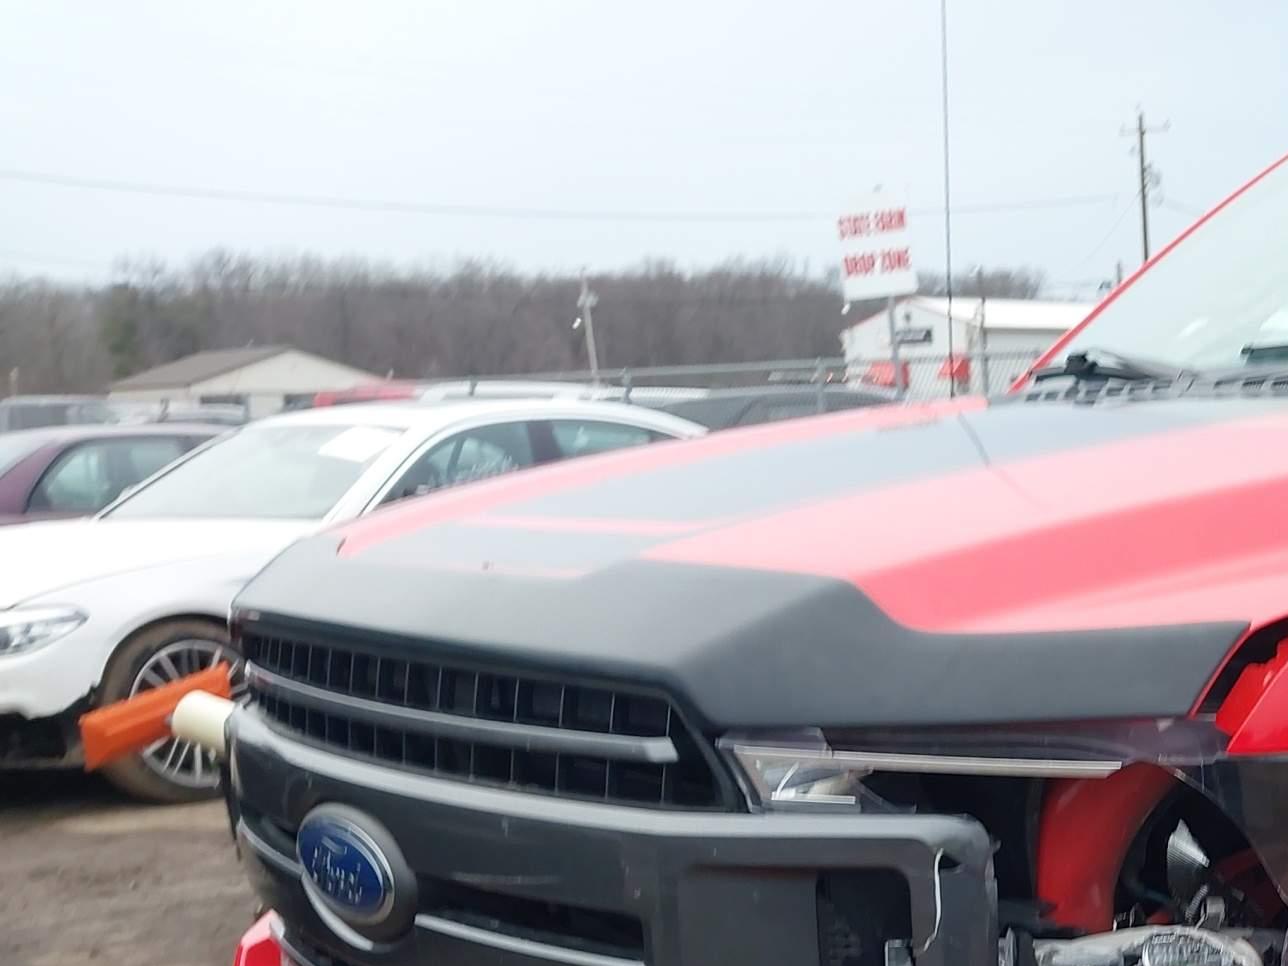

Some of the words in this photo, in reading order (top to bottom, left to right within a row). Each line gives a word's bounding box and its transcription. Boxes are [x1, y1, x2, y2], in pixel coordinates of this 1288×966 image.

[838, 213, 871, 240] STATE
[844, 253, 876, 278] DROP
[880, 247, 911, 273] ZONE
